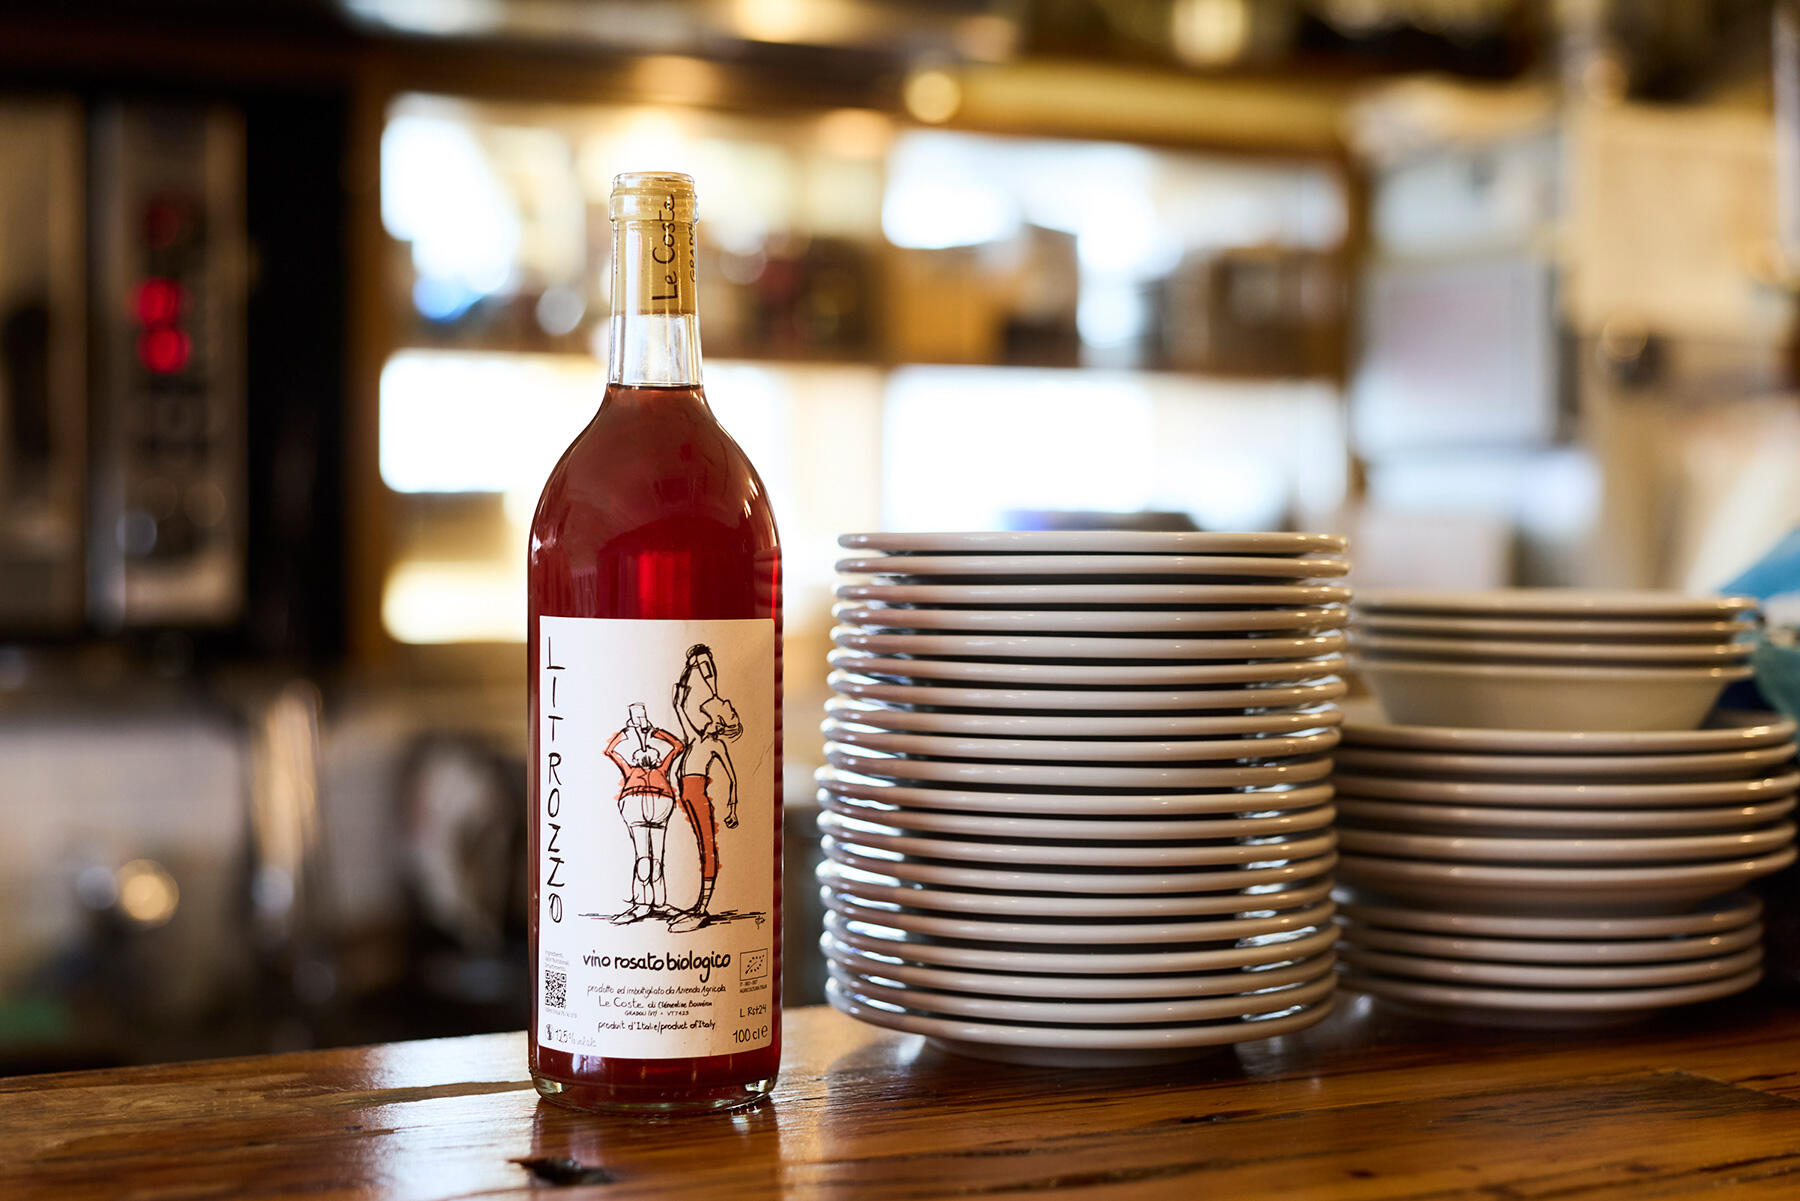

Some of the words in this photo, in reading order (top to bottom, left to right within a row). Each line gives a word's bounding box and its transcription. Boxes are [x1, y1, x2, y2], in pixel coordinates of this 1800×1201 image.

[652, 193, 675, 265] Coste
[652, 271, 678, 301] Le
[546, 636, 565, 924] LITROZZO
[583, 949, 611, 967] vino
[615, 952, 664, 971] rosato
[666, 949, 731, 983] biologico
[587, 983, 614, 996] prodotto
[616, 985, 626, 995] ed
[666, 986, 675, 995] da
[701, 984, 726, 997] Agricola
[599, 995, 611, 1007] Le
[613, 997, 644, 1009] Coste
[647, 1000, 656, 1008] di
[739, 1008, 745, 1017] L
[747, 1004, 766, 1017] Rst24
[598, 1019, 625, 1033] produit
[698, 1019, 716, 1031] Italy
[733, 1028, 751, 1044] 100
[752, 1028, 760, 1040] cl
